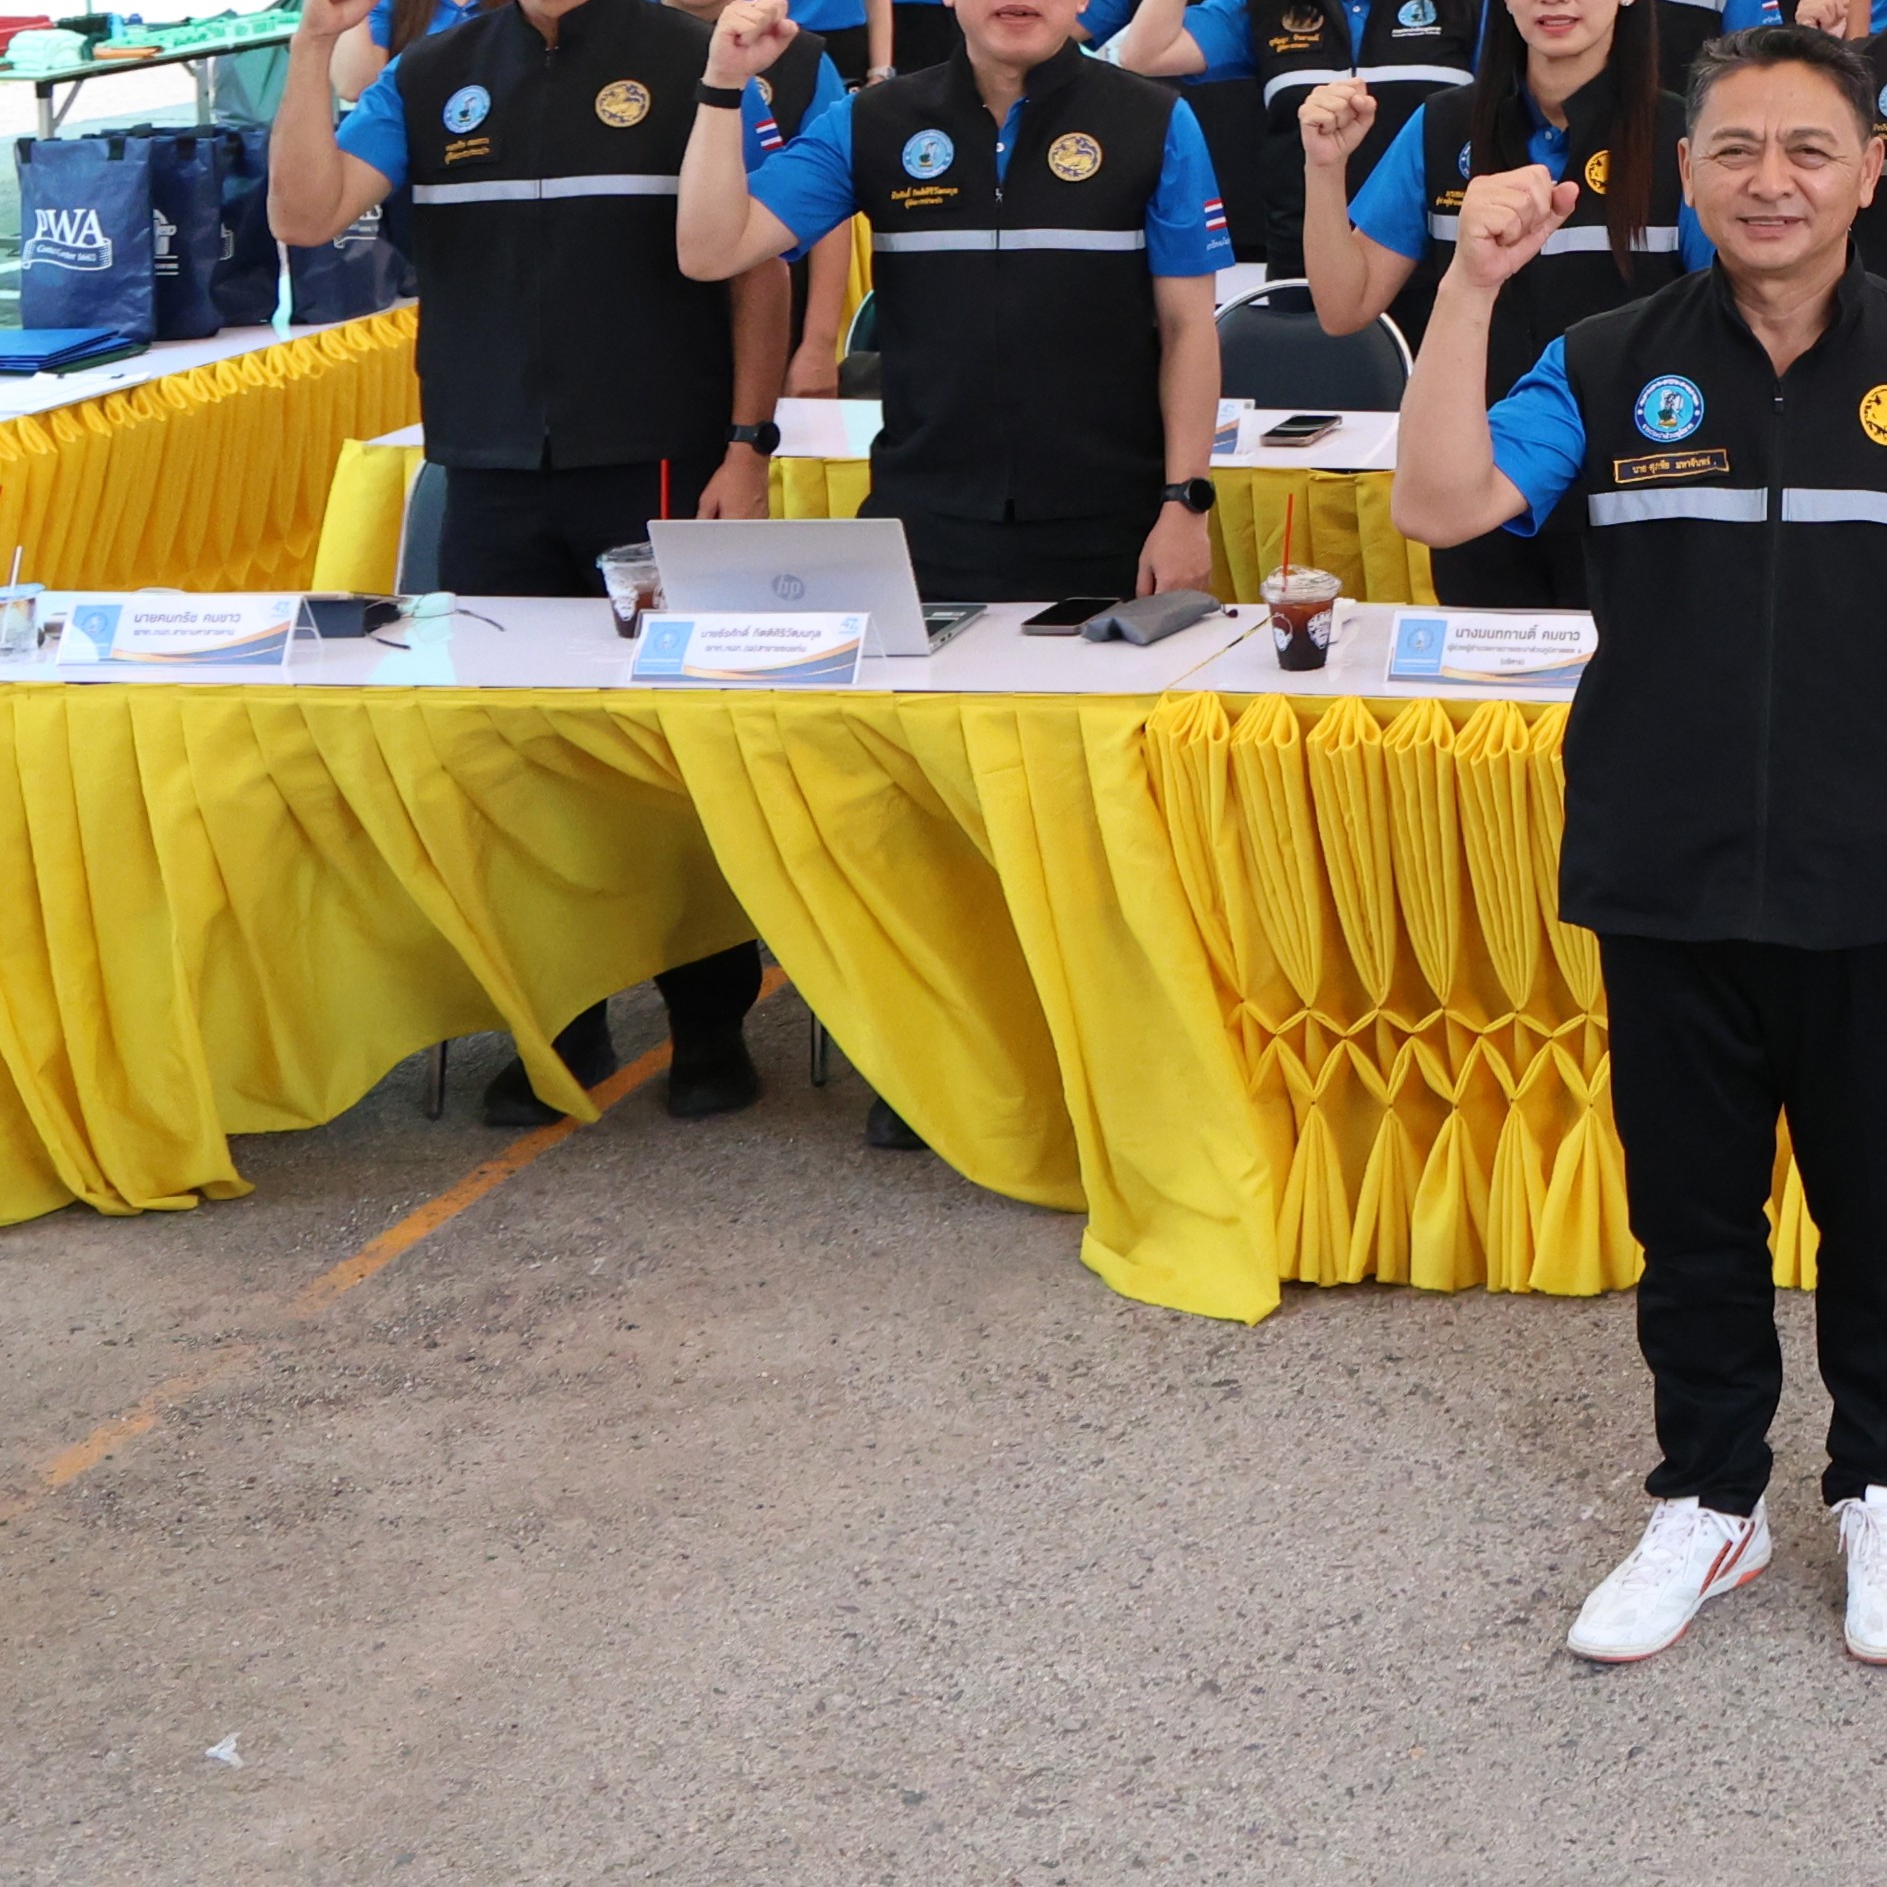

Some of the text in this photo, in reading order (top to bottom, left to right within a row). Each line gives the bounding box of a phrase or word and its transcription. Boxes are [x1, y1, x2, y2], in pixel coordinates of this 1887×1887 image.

[34, 208, 104, 247] PWA
[779, 575, 800, 595] hp
[1541, 630, 1581, 642] คมขาว
